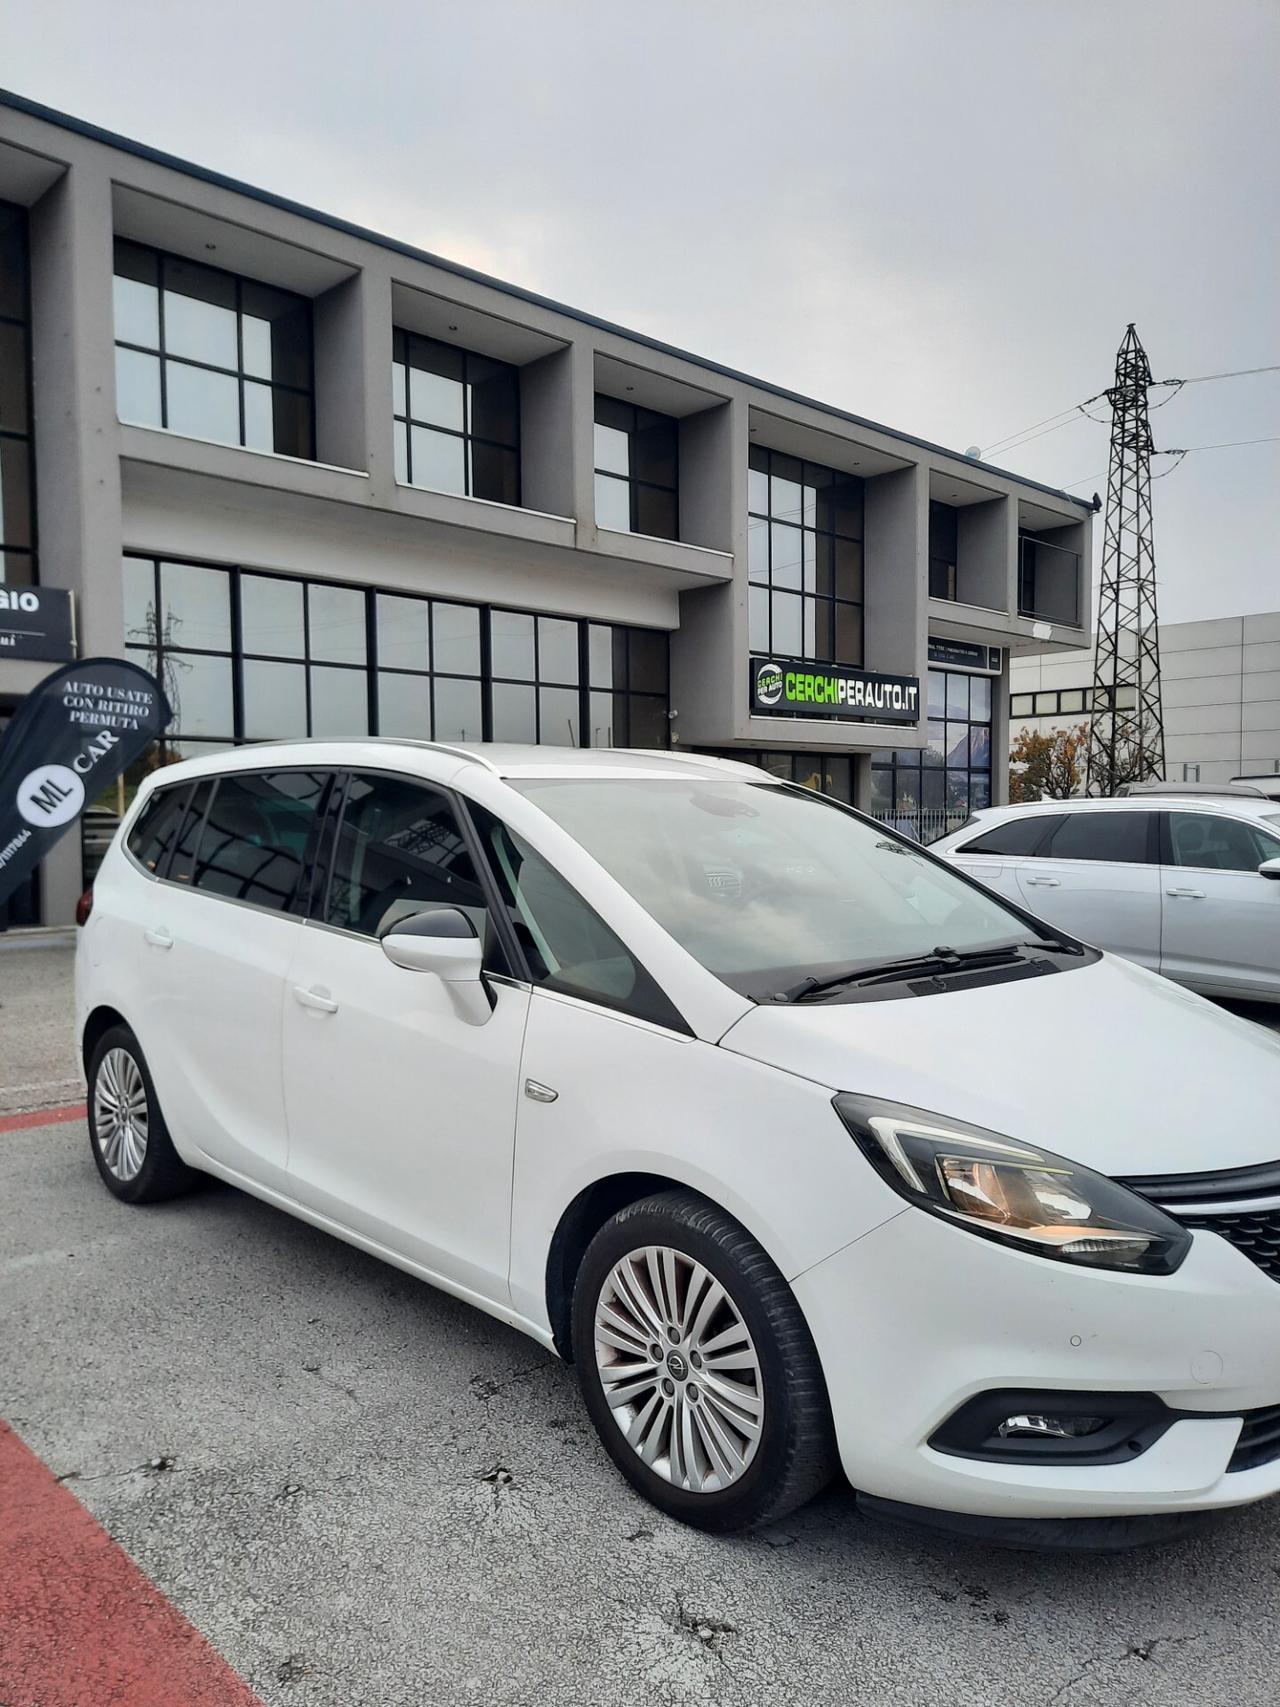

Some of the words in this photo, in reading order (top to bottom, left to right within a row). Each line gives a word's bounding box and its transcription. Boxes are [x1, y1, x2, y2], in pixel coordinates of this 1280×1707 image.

[757, 672, 783, 687] CERCHI
[757, 684, 769, 696] PER
[769, 681, 783, 693] AUTO
[63, 681, 104, 697] AUTO
[106, 686, 153, 705] USATE
[785, 672, 917, 711] CERCHIPERAUTO.IT
[63, 695, 94, 709] CON
[97, 699, 150, 717] RITIRO
[69, 710, 139, 730] PERMUTA
[30, 778, 74, 814] ML
[73, 730, 120, 773] CAR
